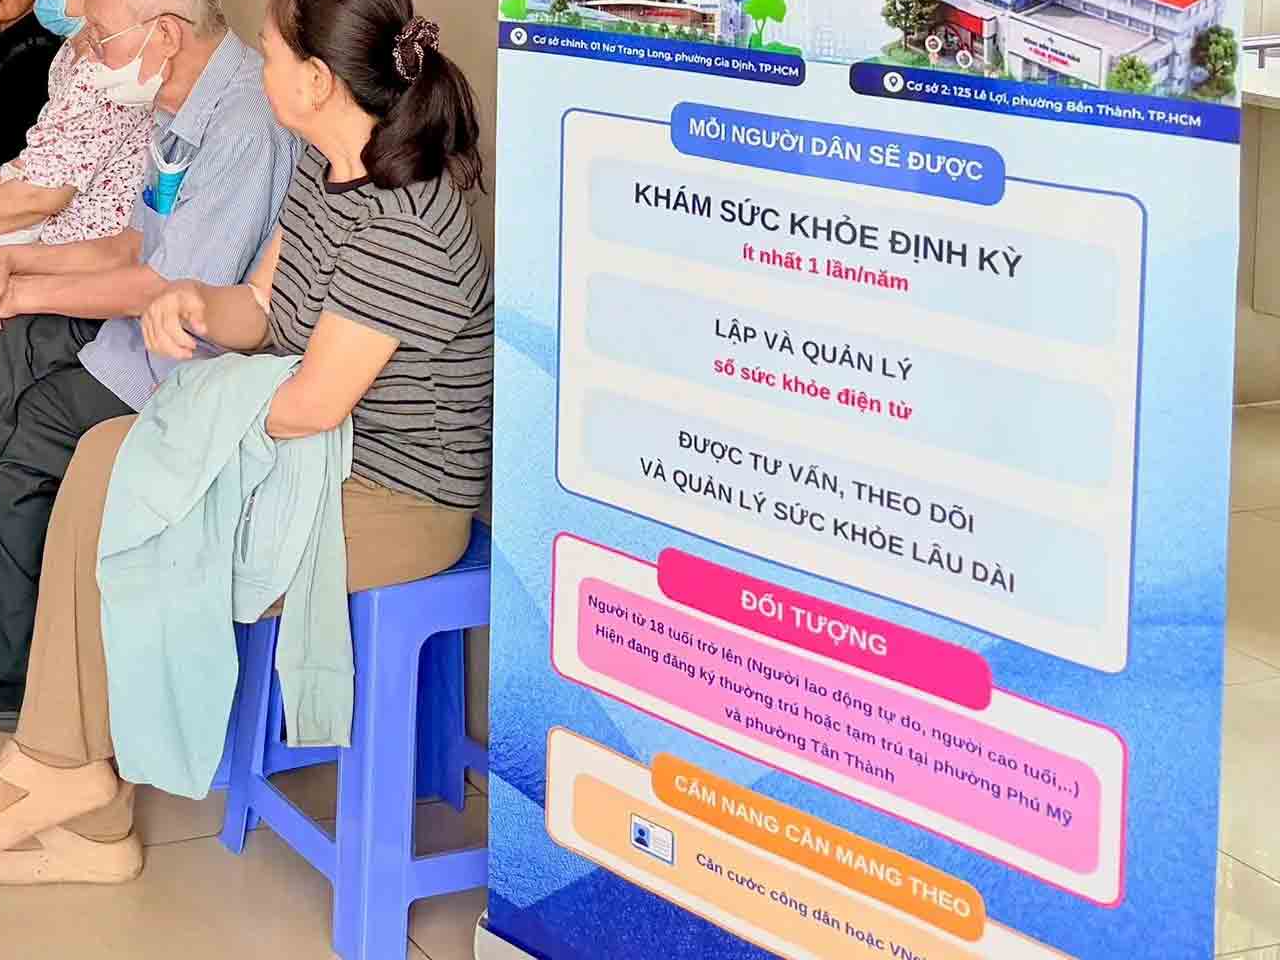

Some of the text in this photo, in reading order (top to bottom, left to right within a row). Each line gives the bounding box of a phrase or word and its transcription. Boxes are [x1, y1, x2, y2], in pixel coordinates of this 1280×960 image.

[618, 44, 645, 59] Trang
[647, 47, 673, 62] Long,
[674, 51, 713, 68] phường
[714, 55, 730, 69] Gia
[759, 63, 799, 77] TP.HCM
[906, 80, 923, 92] Cơ
[925, 81, 938, 93] sở
[953, 87, 972, 98] 125
[1011, 94, 1063, 113] phường
[1147, 110, 1201, 127] TP.HCM
[689, 116, 983, 181] MỖI NGƯỜI DÂN SẼ ĐƯỢC
[634, 181, 1022, 278] KHÁM SỨC KHỎE ĐỊNH KỲ
[743, 242, 909, 292] ít nhất 1 lần/năm
[715, 318, 913, 381] LẬP VÀ QUẢN LÝ
[740, 366, 776, 387] sức
[782, 373, 831, 400] khỏe
[837, 388, 881, 413] điện
[679, 430, 975, 534] ĐƯỢC TƯ VẤN, THEO DÕI
[640, 457, 1015, 593] VÀ QUẢN LÝ SỨC KHỎE LÂU DÀI
[741, 589, 888, 657] ĐỐI TƯỢNG
[587, 594, 629, 621] Người
[650, 619, 665, 634] 18
[721, 647, 743, 666] lên
[747, 657, 800, 688] (Người
[804, 677, 827, 697] lao
[832, 686, 872, 717] động
[878, 705, 896, 722] tự
[901, 715, 926, 736] do,
[931, 726, 983, 757] người
[987, 750, 1018, 771] cao
[627, 637, 659, 663] đang
[663, 652, 696, 678] đăng
[699, 666, 716, 687] ký
[719, 675, 773, 710] thường
[778, 696, 799, 717] trú
[804, 706, 841, 733] hoặc
[847, 724, 876, 746] tạm
[881, 737, 903, 756] trú
[908, 747, 929, 767] tại
[933, 759, 1001, 800] phường
[1007, 786, 1040, 812] Phú
[1046, 802, 1073, 827] Mỹ
[725, 705, 895, 785] và phường Tân Thành
[720, 794, 779, 834] NANG
[835, 844, 903, 887] MANG
[908, 874, 971, 919] THEO
[727, 868, 765, 896] cước
[769, 889, 808, 917] công
[812, 907, 841, 932] dân
[845, 920, 884, 951] hoặc
